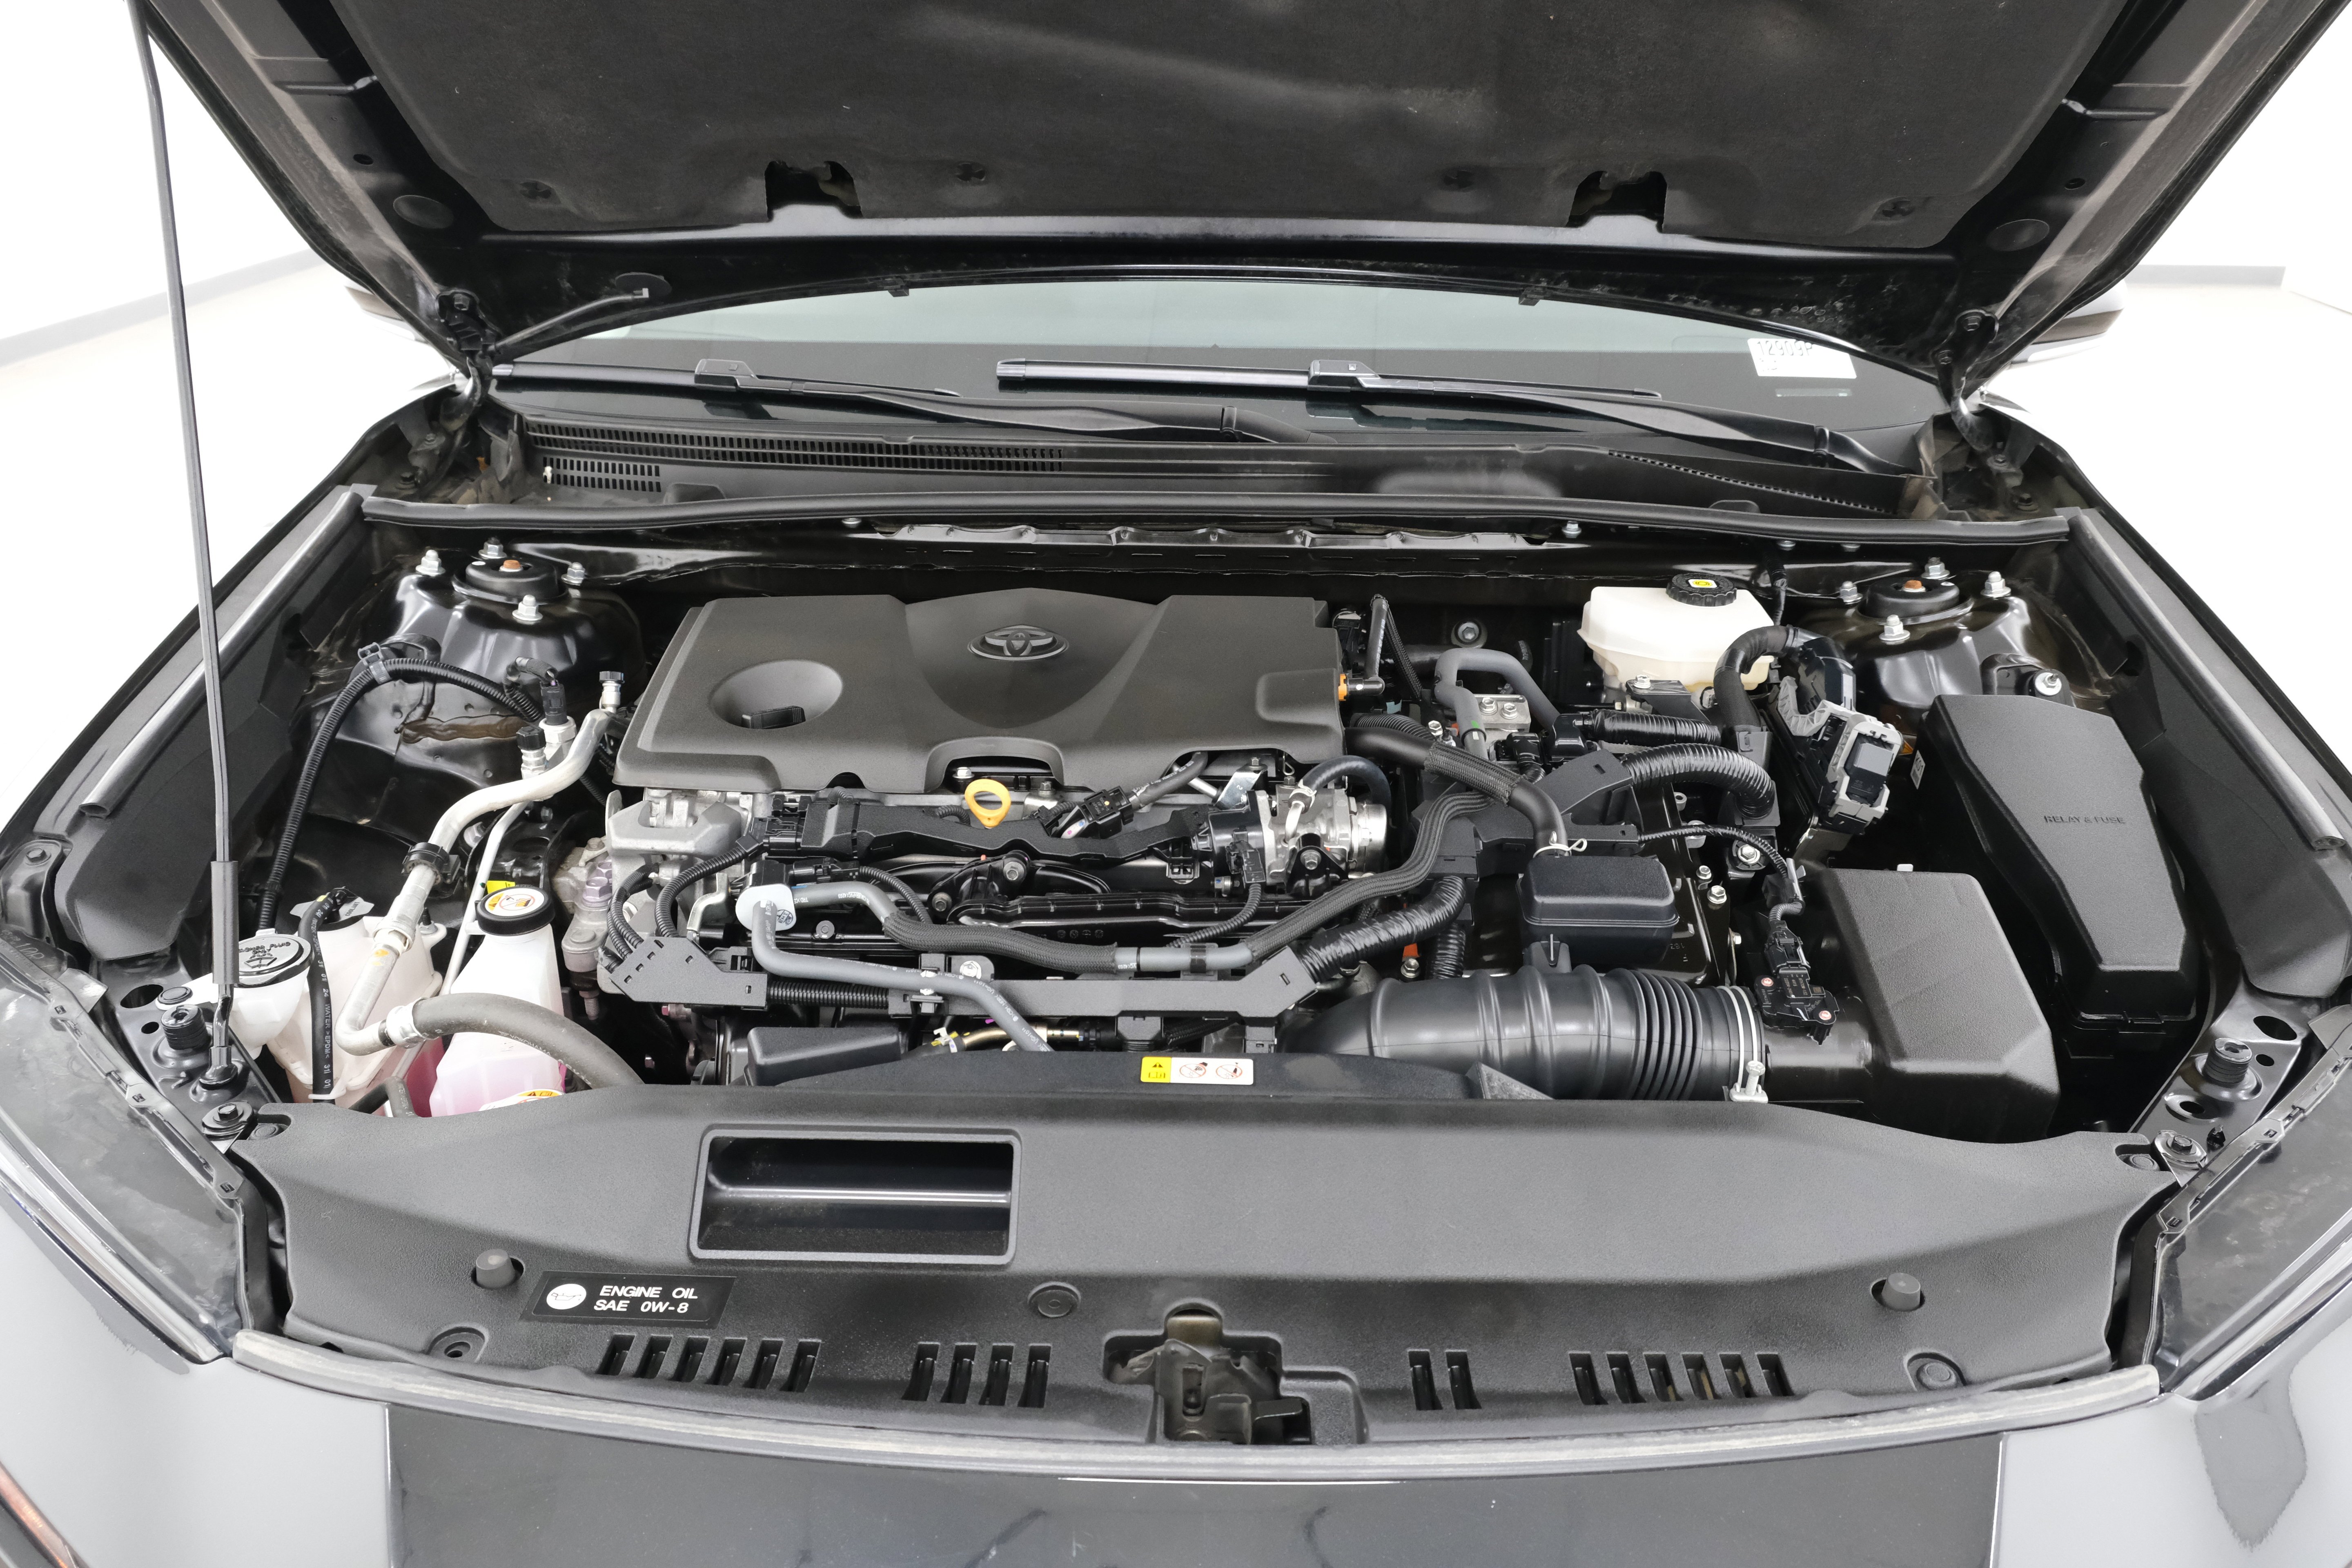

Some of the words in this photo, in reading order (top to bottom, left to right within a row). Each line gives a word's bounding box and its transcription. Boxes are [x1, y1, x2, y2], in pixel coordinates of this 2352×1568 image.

[2044, 815, 2081, 824] RELAY
[2094, 816, 2125, 824] FUSE
[345, 901, 361, 917] COOLANT
[600, 1285, 662, 1298] ENGINE
[672, 1287, 698, 1299] OIL
[594, 1299, 630, 1311] SAE
[641, 1301, 689, 1313] 0W-8
